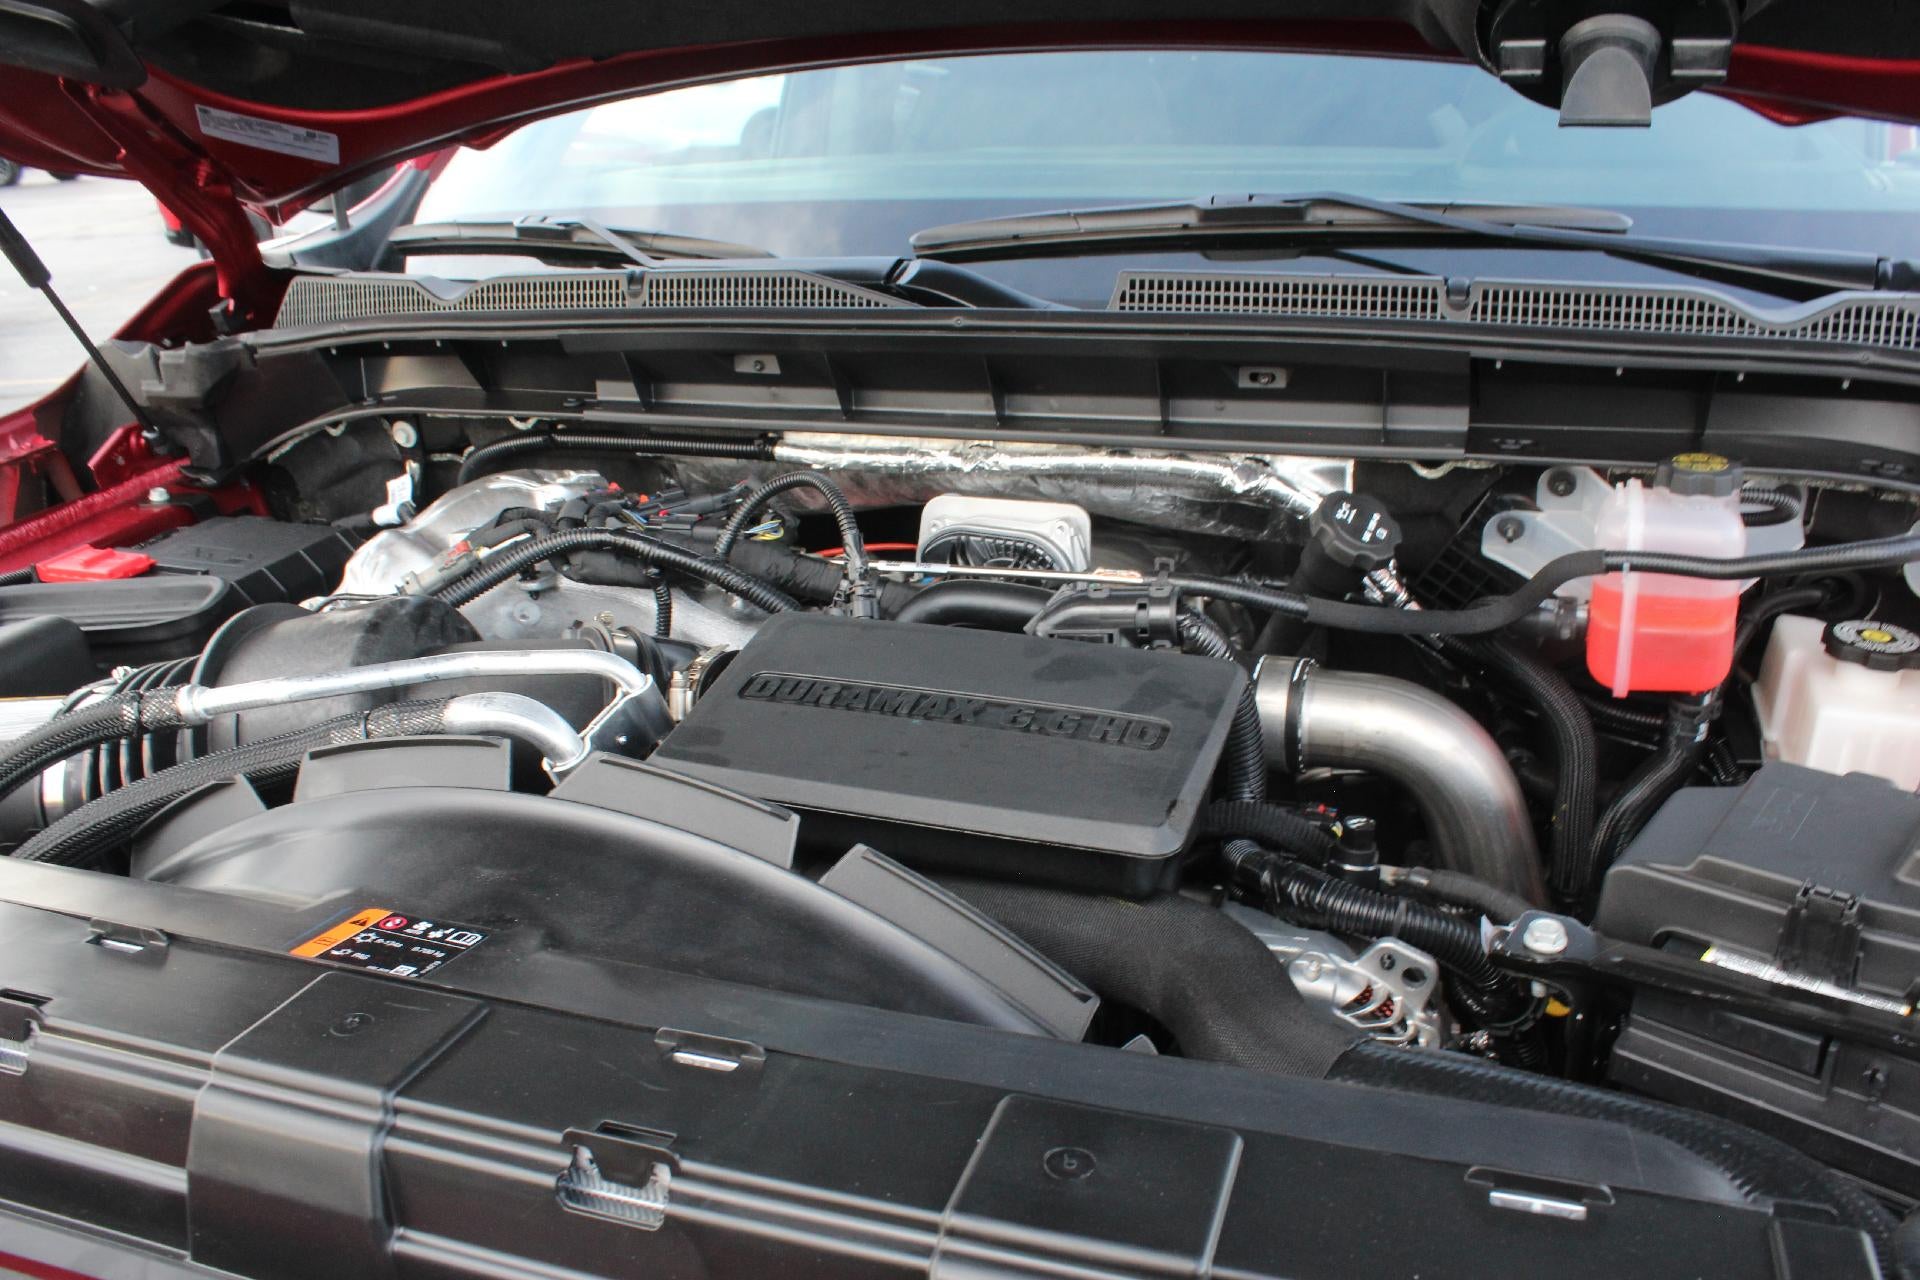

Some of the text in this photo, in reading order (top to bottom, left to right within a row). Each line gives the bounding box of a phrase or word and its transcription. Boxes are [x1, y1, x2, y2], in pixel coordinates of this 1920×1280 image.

[745, 675, 1162, 748] DURAMAX 6.6 HD
